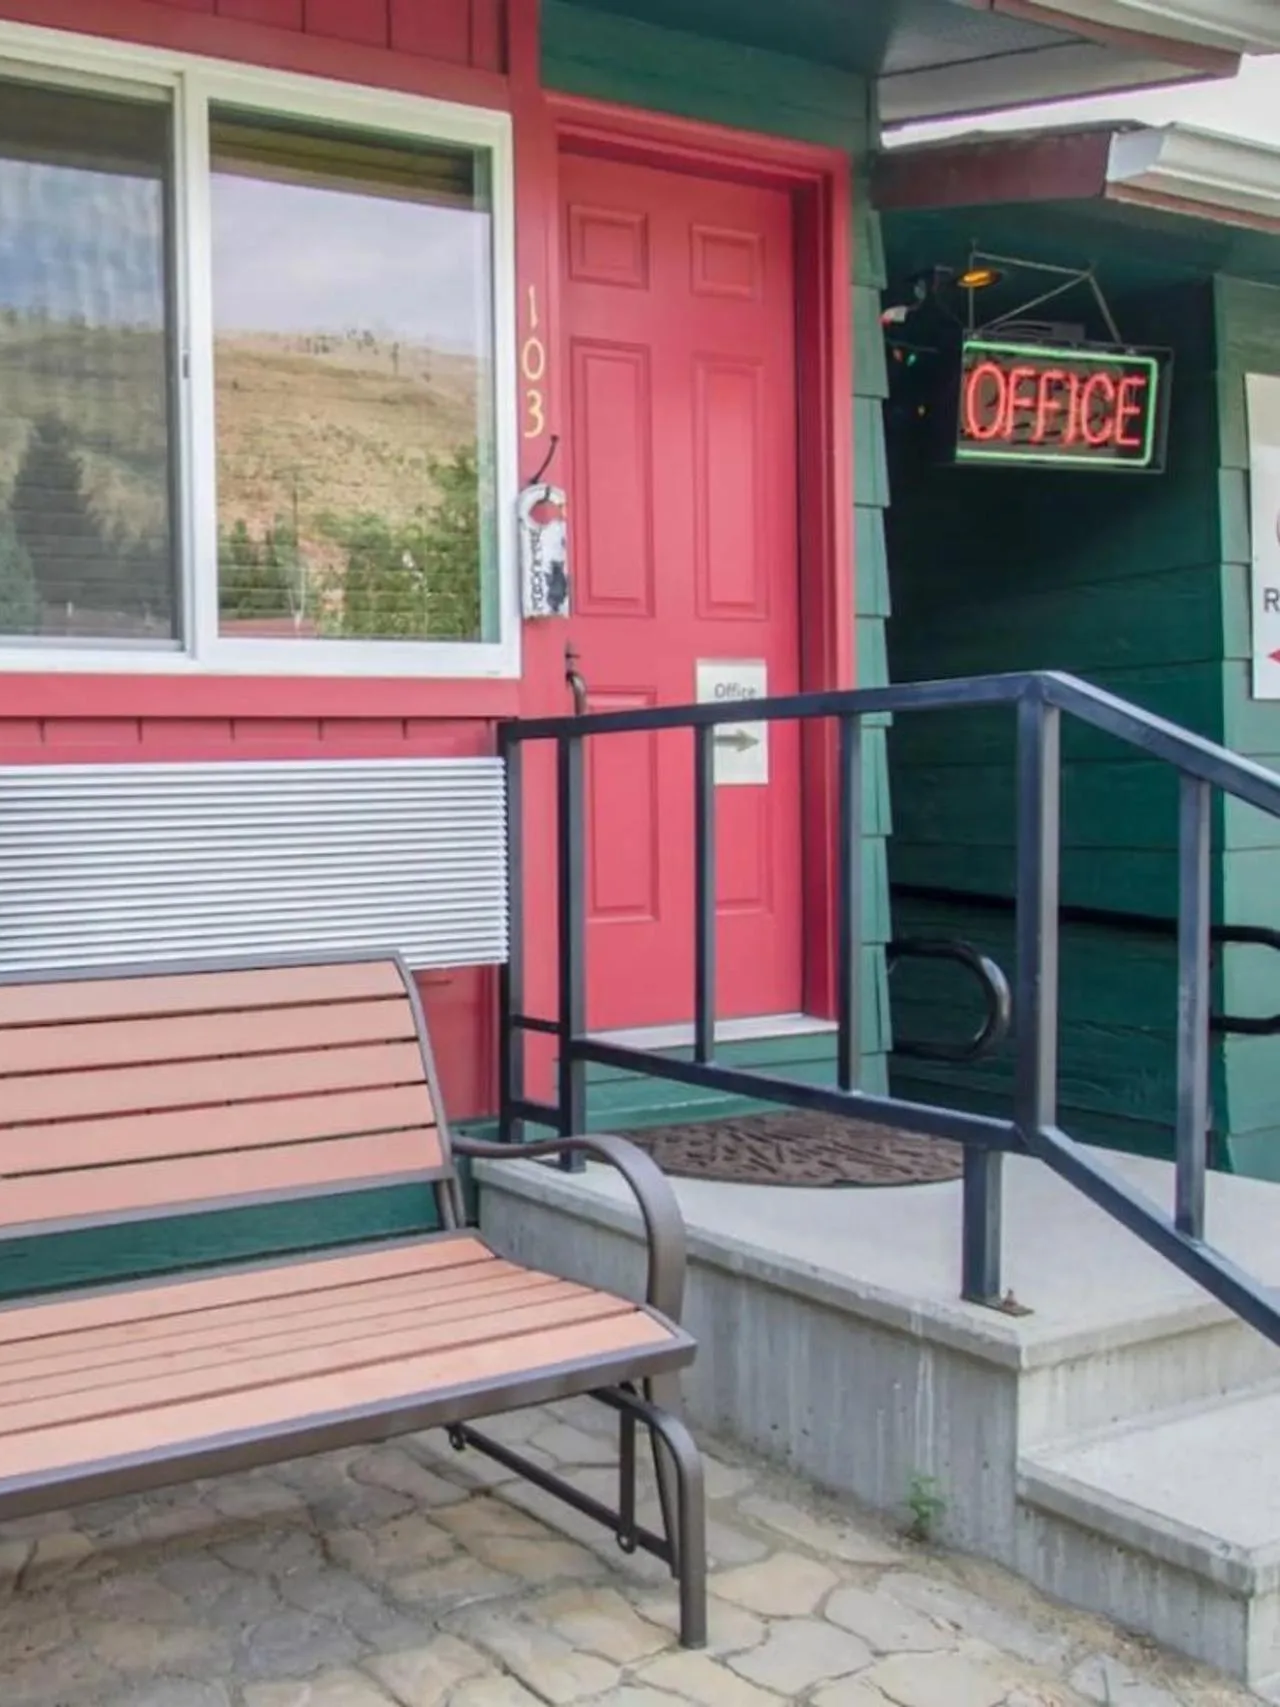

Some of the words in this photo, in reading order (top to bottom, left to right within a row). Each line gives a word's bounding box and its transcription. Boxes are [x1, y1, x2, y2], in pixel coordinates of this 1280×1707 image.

[522, 284, 546, 438] 103
[966, 362, 1147, 447] OFFICE
[714, 682, 757, 699] Office
